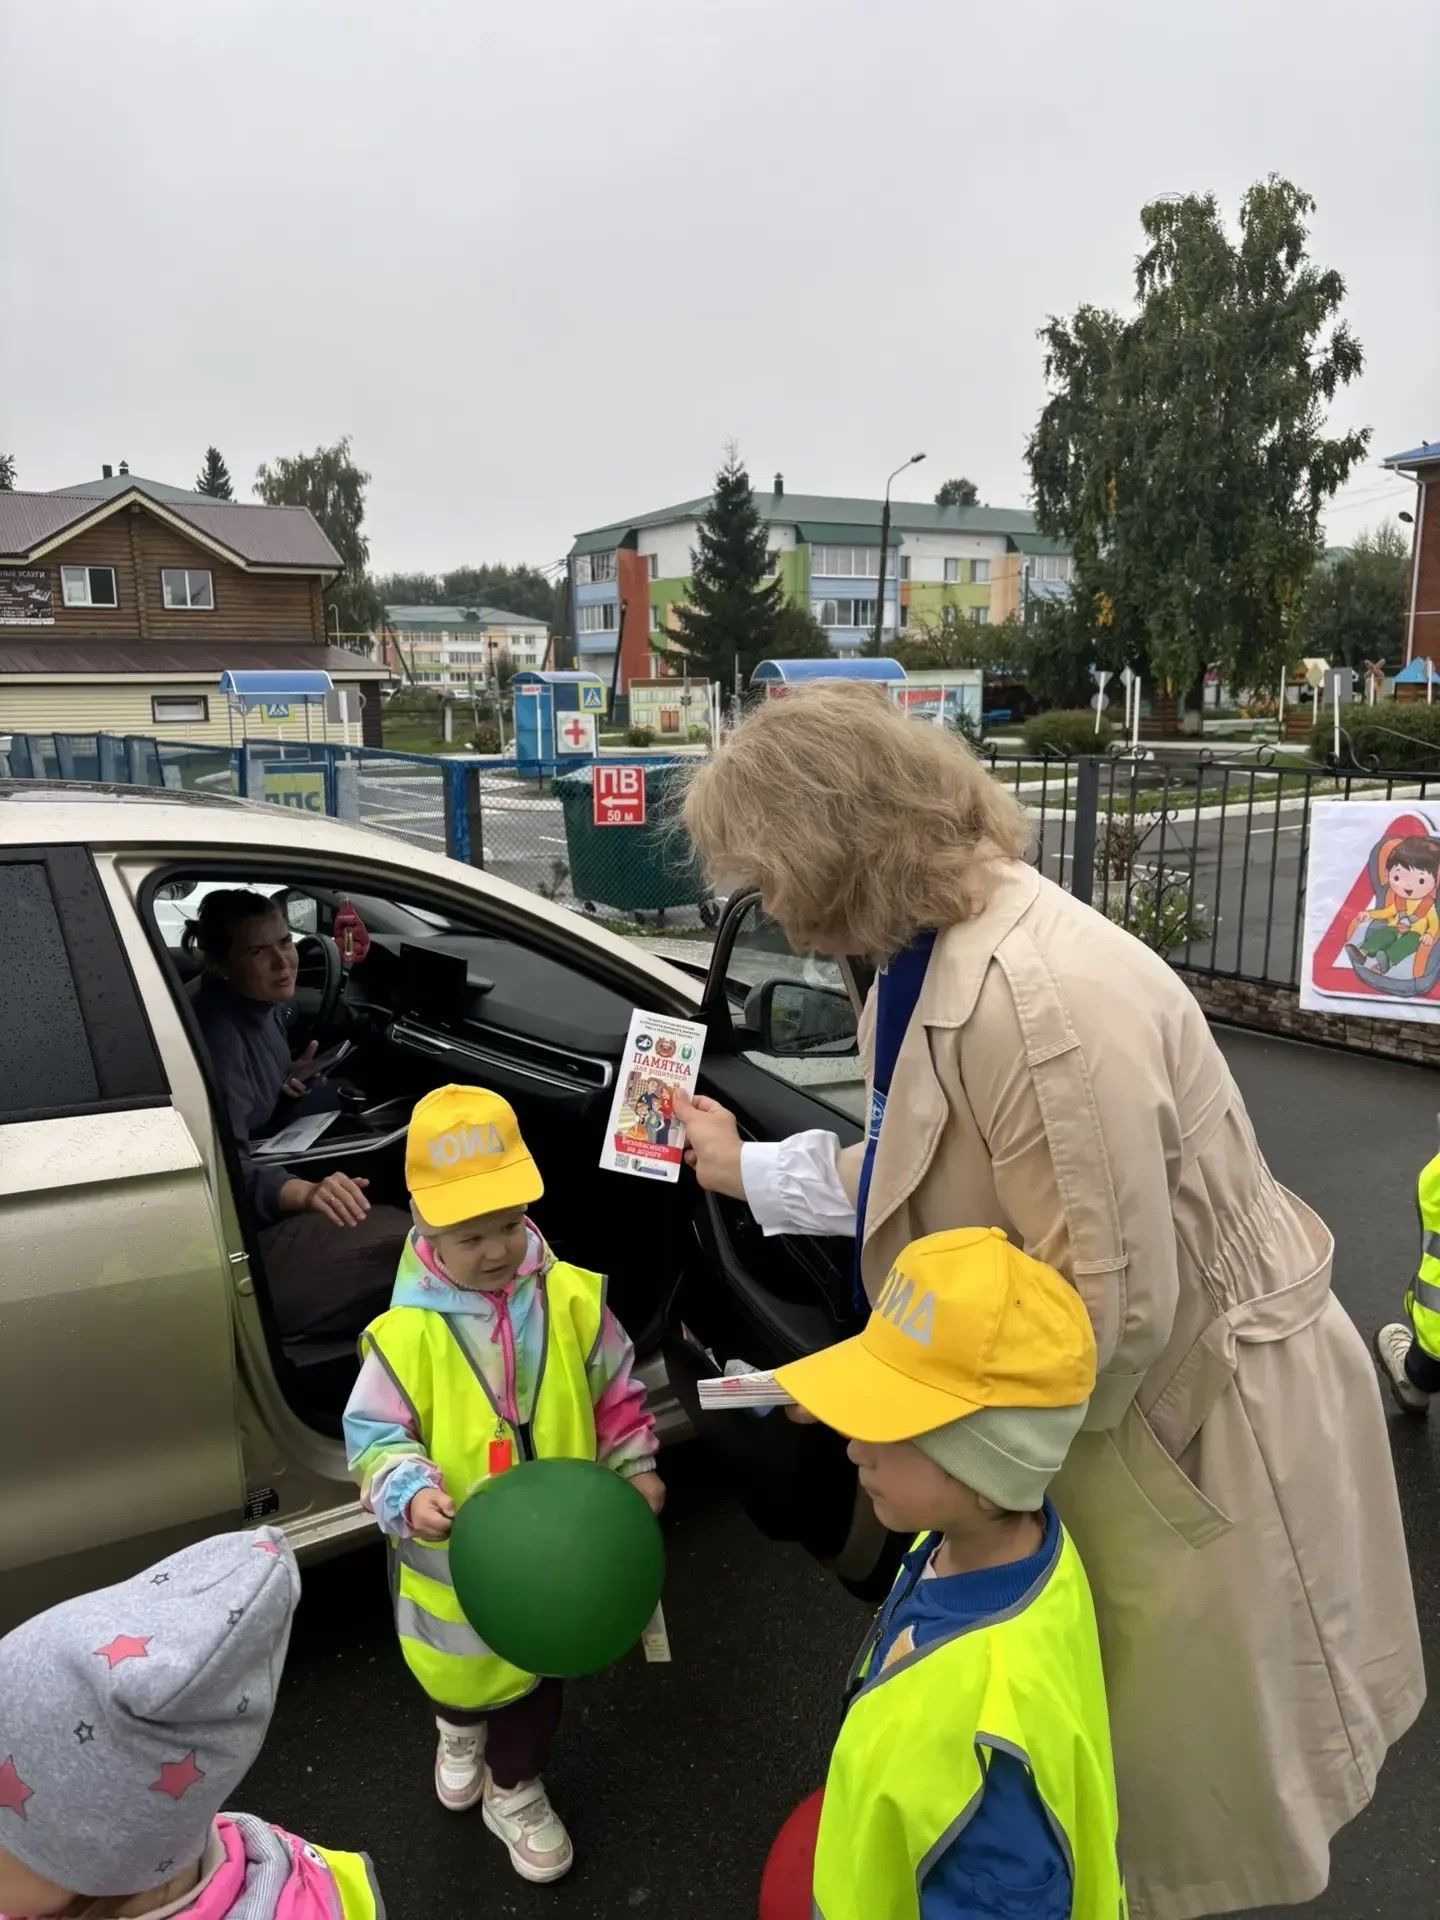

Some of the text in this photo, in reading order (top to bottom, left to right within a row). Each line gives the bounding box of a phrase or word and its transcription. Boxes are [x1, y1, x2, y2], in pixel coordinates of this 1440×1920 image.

[600, 768, 639, 793] ПВ
[607, 810, 621, 821] 50
[633, 1052, 691, 1076] ПАМЯТКА
[428, 1121, 505, 1168] ЮИД
